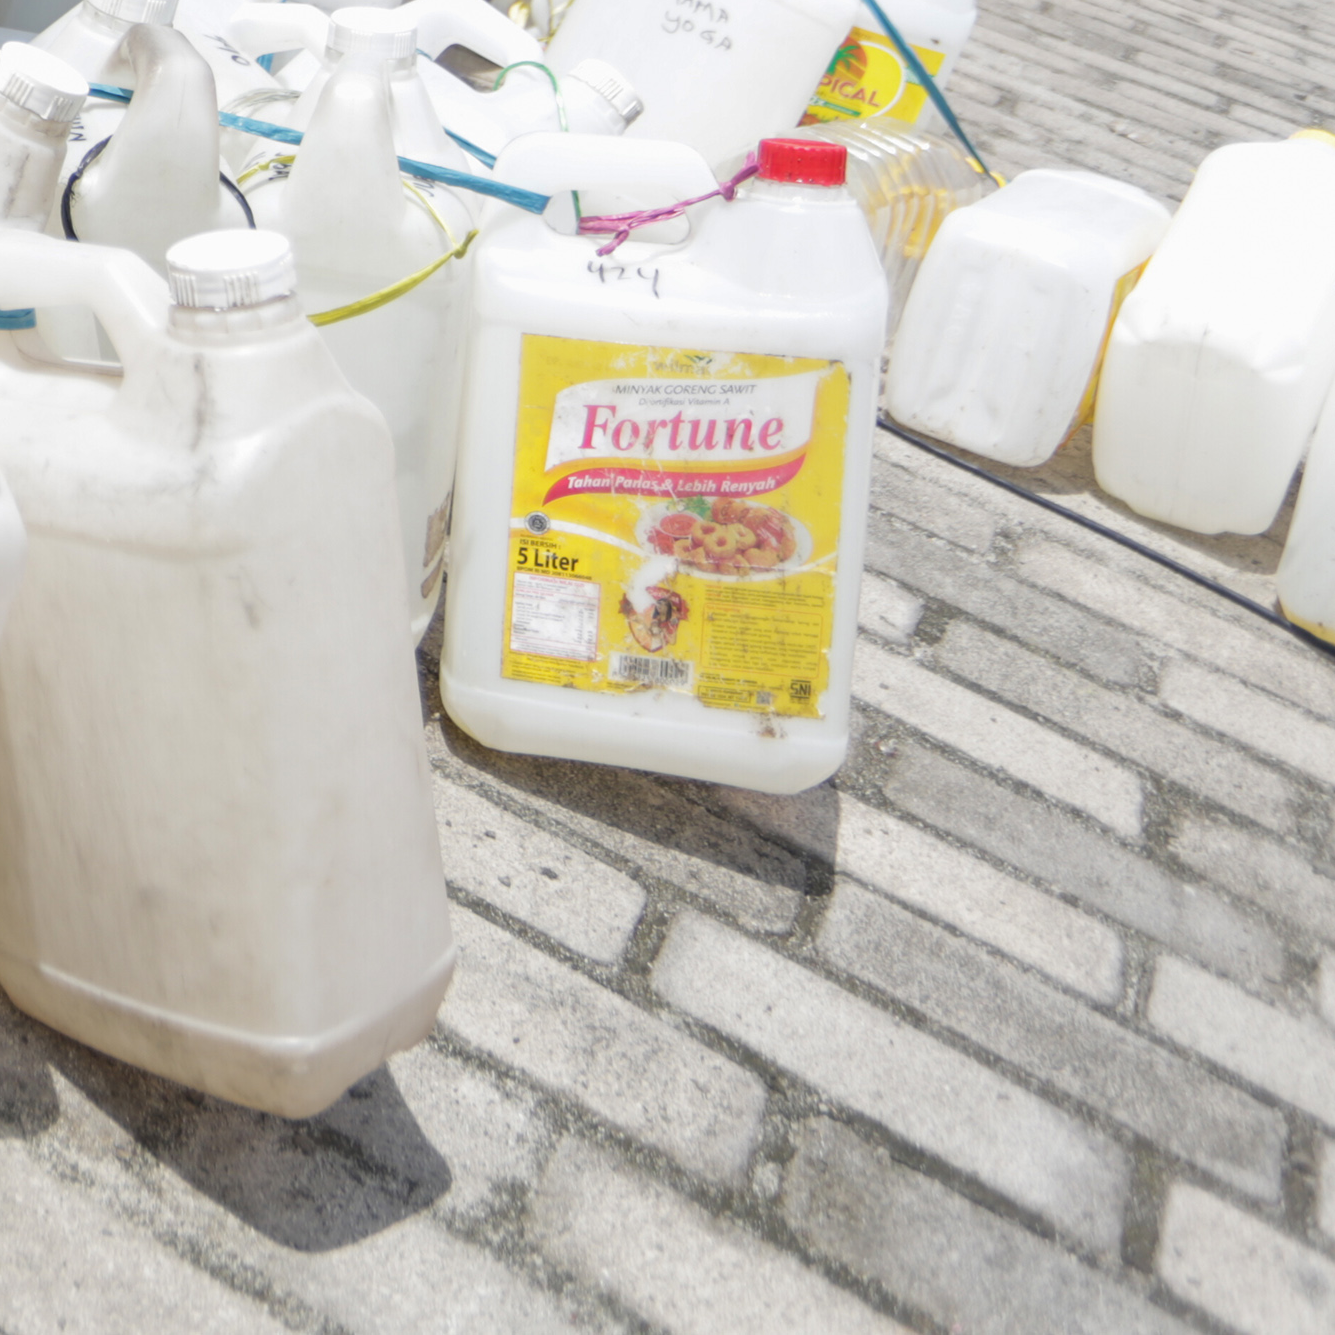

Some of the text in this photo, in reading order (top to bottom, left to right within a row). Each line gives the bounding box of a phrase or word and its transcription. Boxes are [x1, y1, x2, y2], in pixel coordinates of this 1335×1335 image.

[818, 74, 881, 108] PICAL
[587, 260, 660, 300] 424
[615, 384, 758, 396] MINYAK GORENG SAWIT
[688, 397, 721, 406] Vitamin
[722, 398, 730, 406] A
[577, 404, 784, 452] Fortune
[567, 475, 611, 489] Tahan
[677, 478, 717, 493] Lebih
[721, 478, 777, 494] Renyah
[517, 547, 579, 572] 5 Liter
[790, 683, 812, 697] SNI
